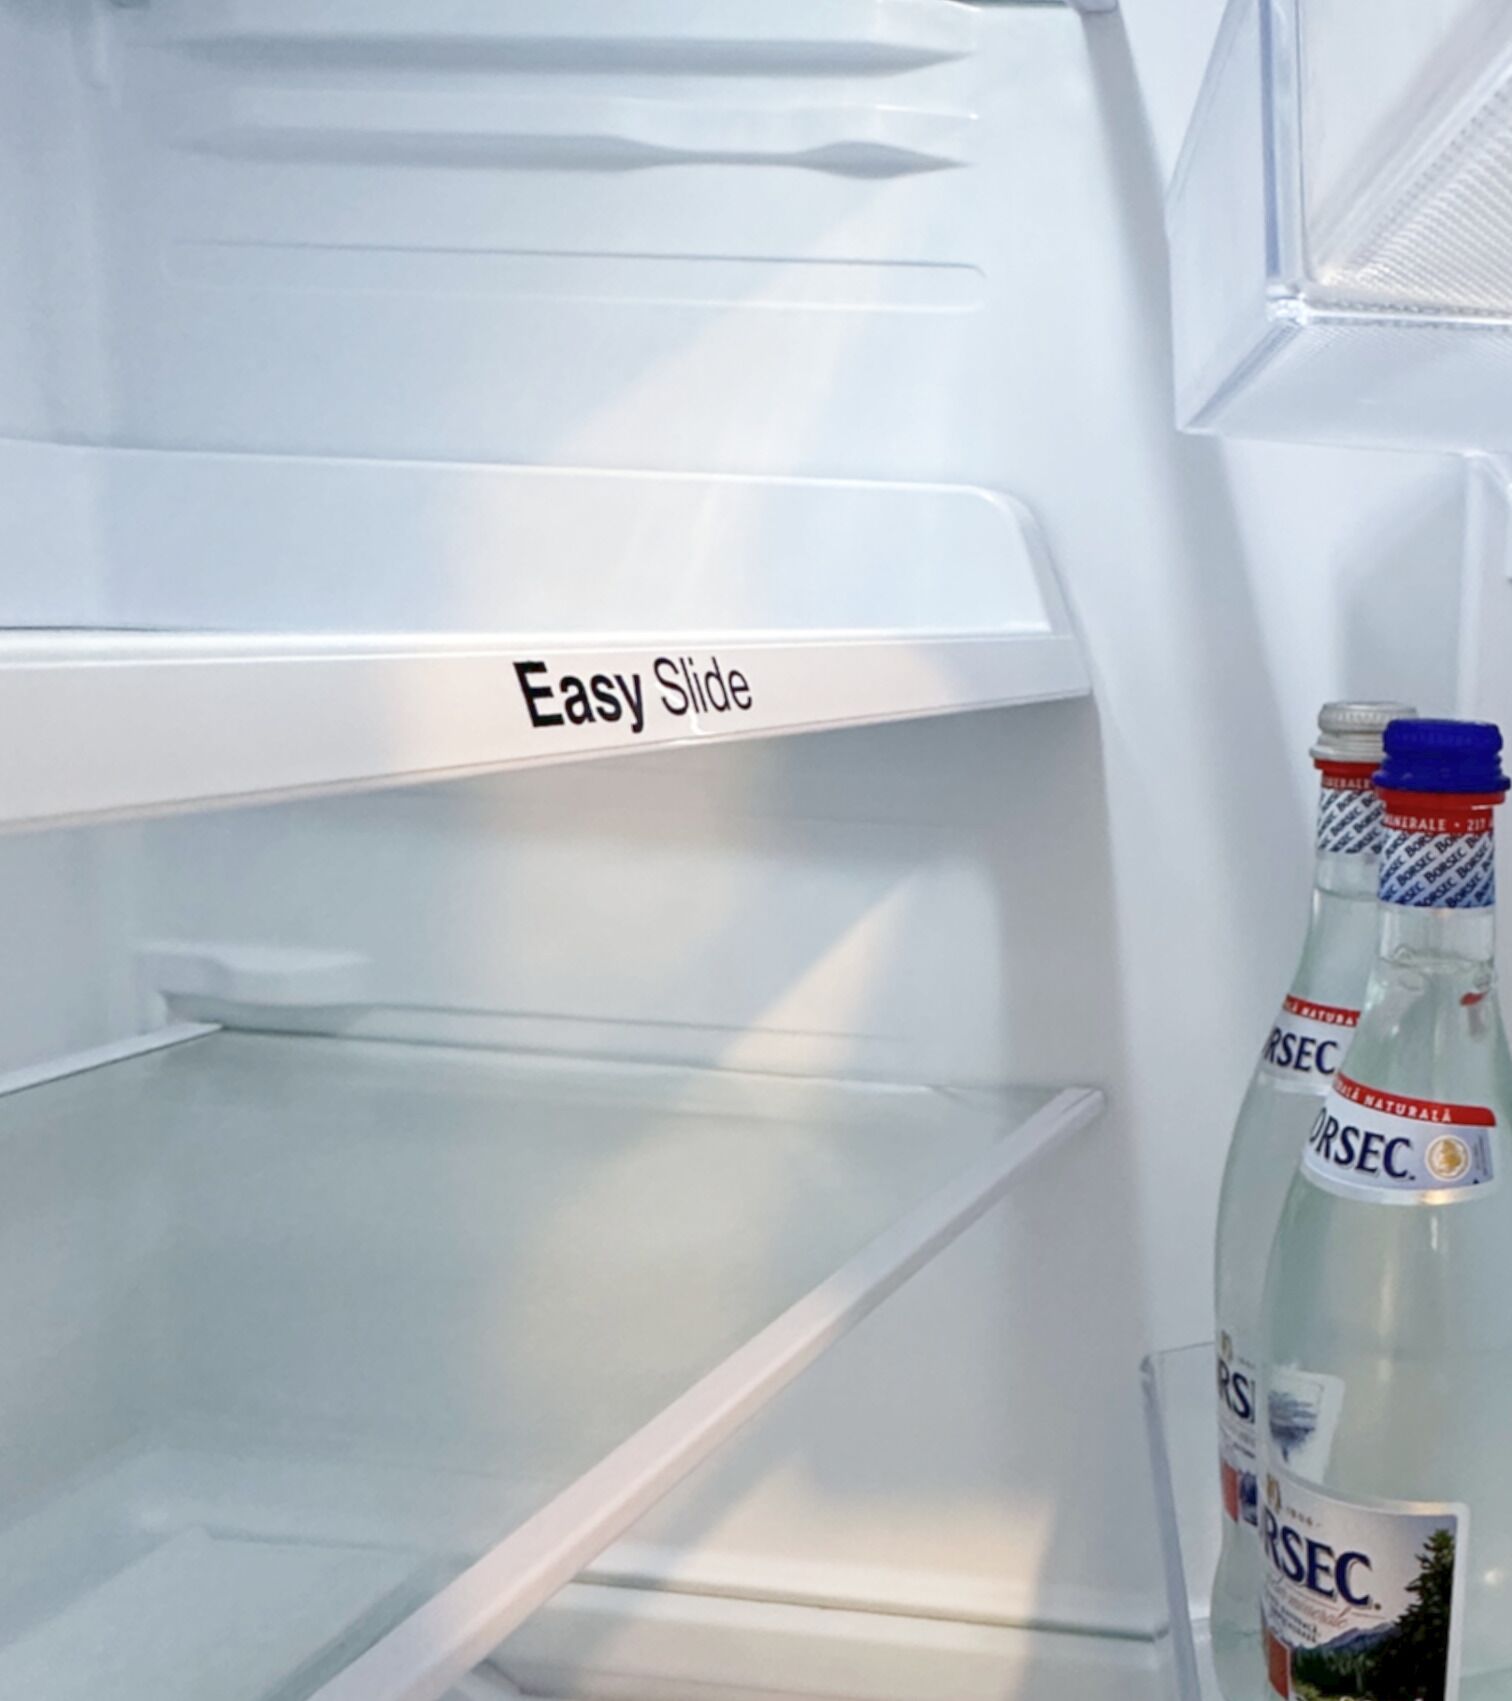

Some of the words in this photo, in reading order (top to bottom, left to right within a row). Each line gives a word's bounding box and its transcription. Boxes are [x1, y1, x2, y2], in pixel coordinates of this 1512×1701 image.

[513, 661, 644, 733] Easy
[653, 656, 752, 716] Slide
[1363, 1094, 1451, 1122] NATURALĂ
[1218, 1359, 1256, 1424] RS
